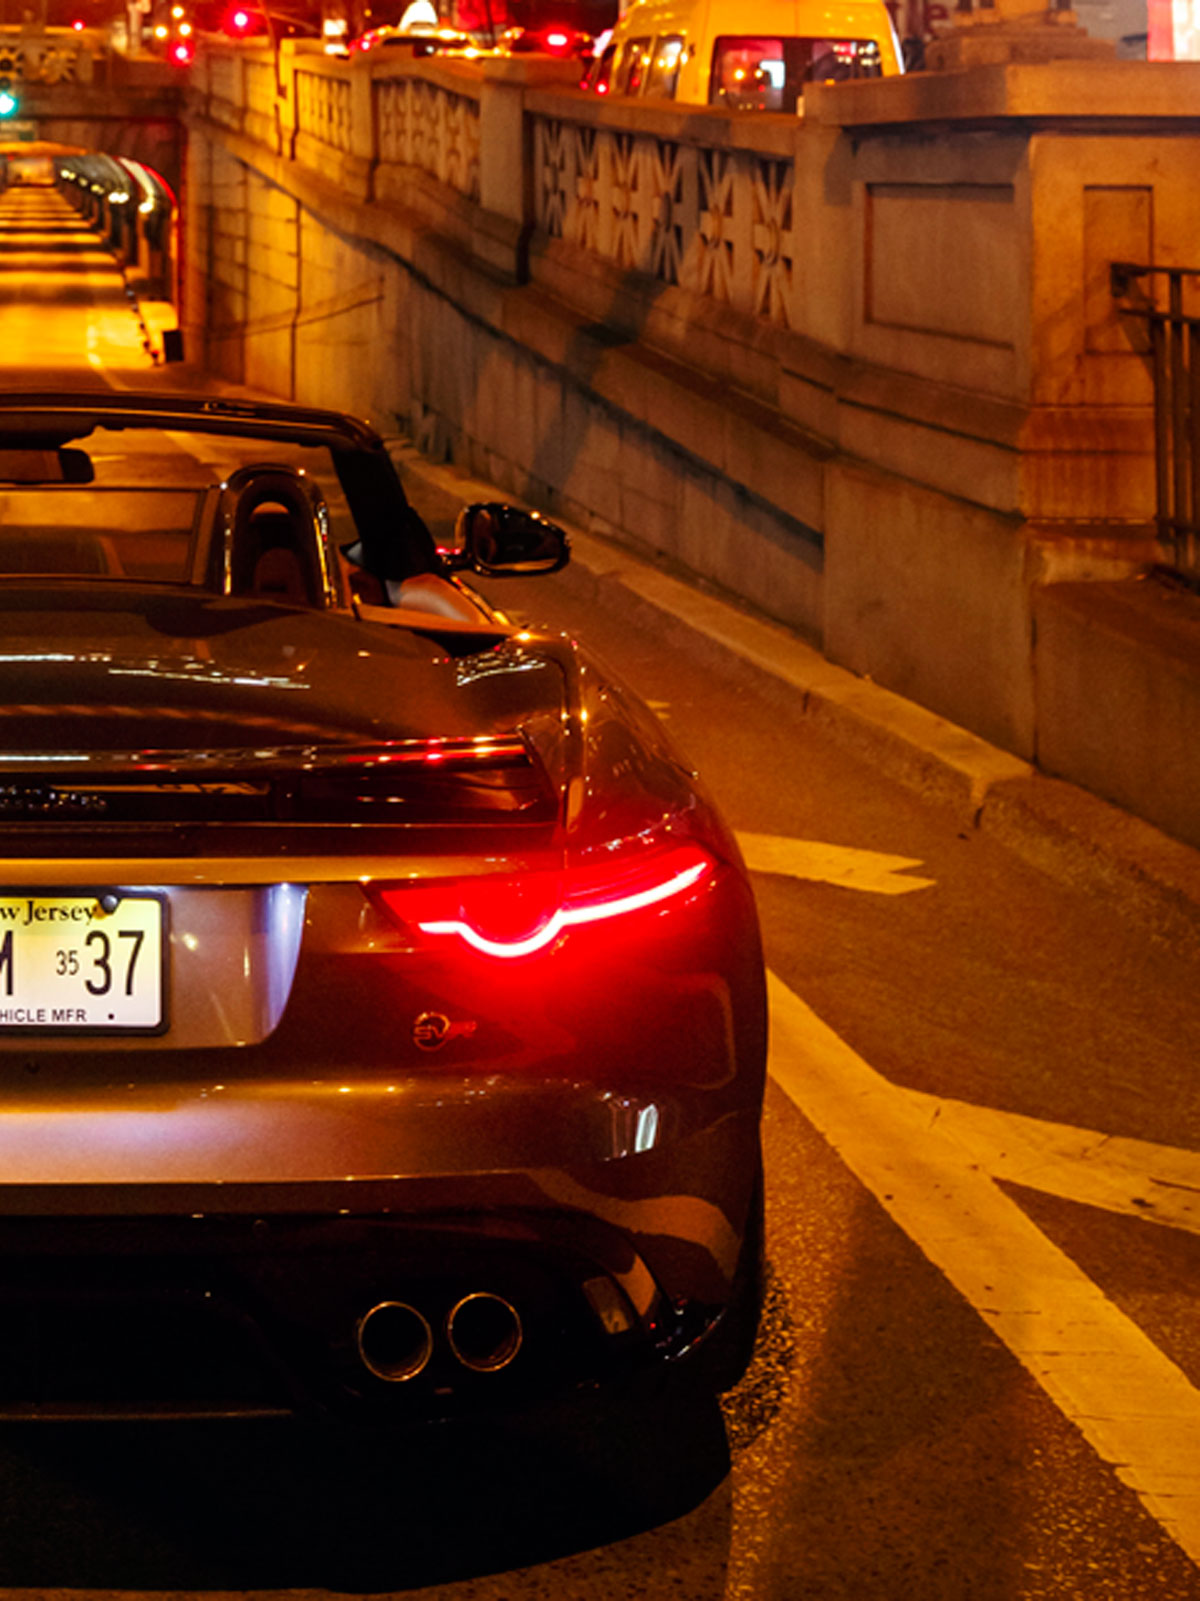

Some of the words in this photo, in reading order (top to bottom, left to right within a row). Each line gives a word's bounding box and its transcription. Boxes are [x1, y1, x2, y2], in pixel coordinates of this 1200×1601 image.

[24, 900, 97, 925] Jersey
[56, 950, 80, 976] 35
[85, 930, 145, 996] 37
[52, 1009, 87, 1023] MFR
